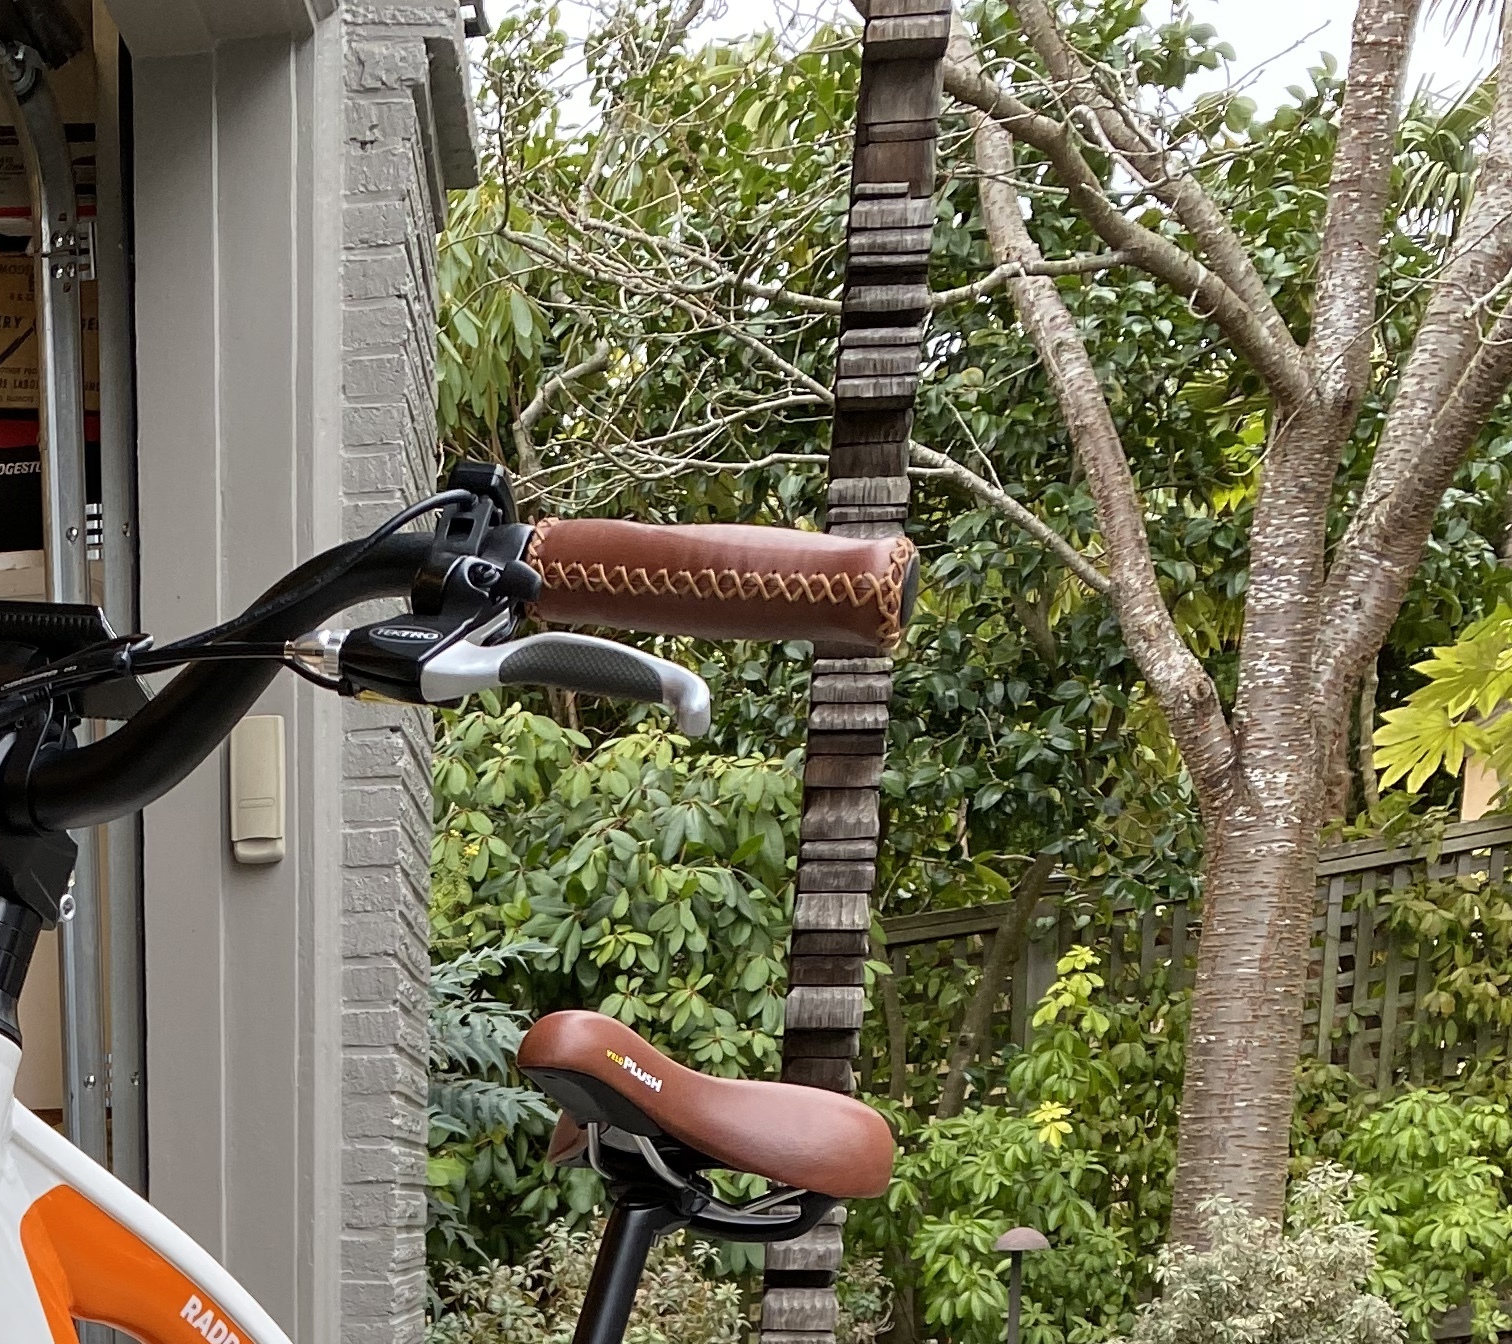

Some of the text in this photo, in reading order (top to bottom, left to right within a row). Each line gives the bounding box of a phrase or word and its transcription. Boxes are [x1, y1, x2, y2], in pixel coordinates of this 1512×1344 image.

[377, 628, 439, 640] TEKTRO
[606, 1049, 663, 1093] VELO PLUSH
